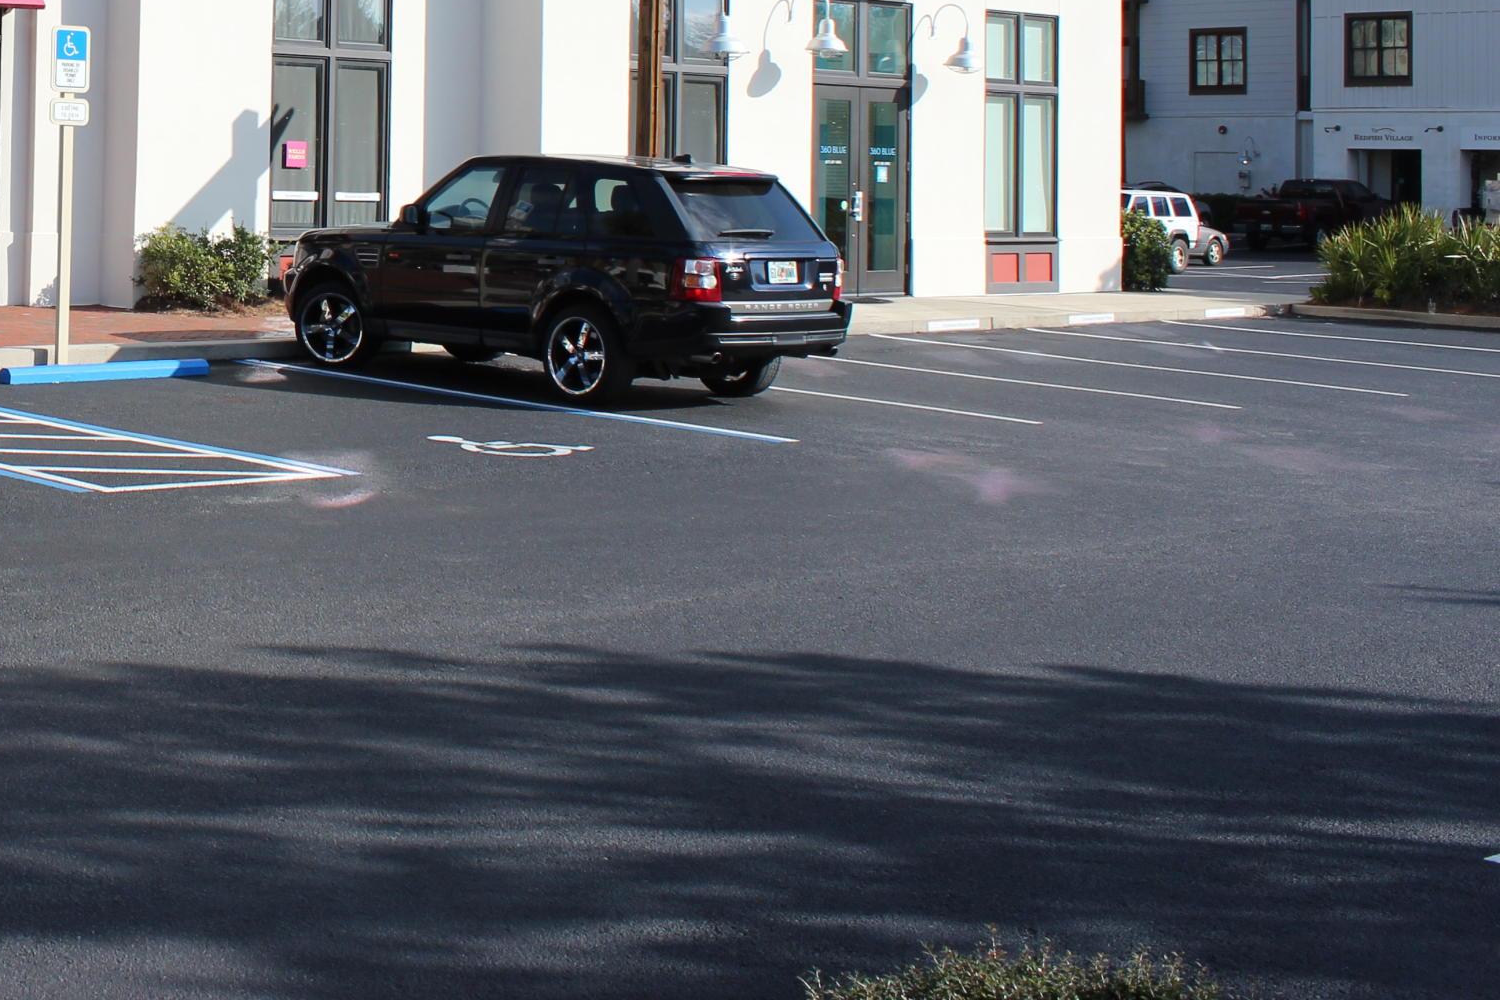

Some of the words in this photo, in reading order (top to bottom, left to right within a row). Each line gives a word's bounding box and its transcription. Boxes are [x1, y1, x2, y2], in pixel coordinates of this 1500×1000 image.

[820, 145, 832, 154] 360
[832, 146, 847, 154] BLUE
[869, 147, 881, 155] 360
[881, 147, 897, 156] BLUE
